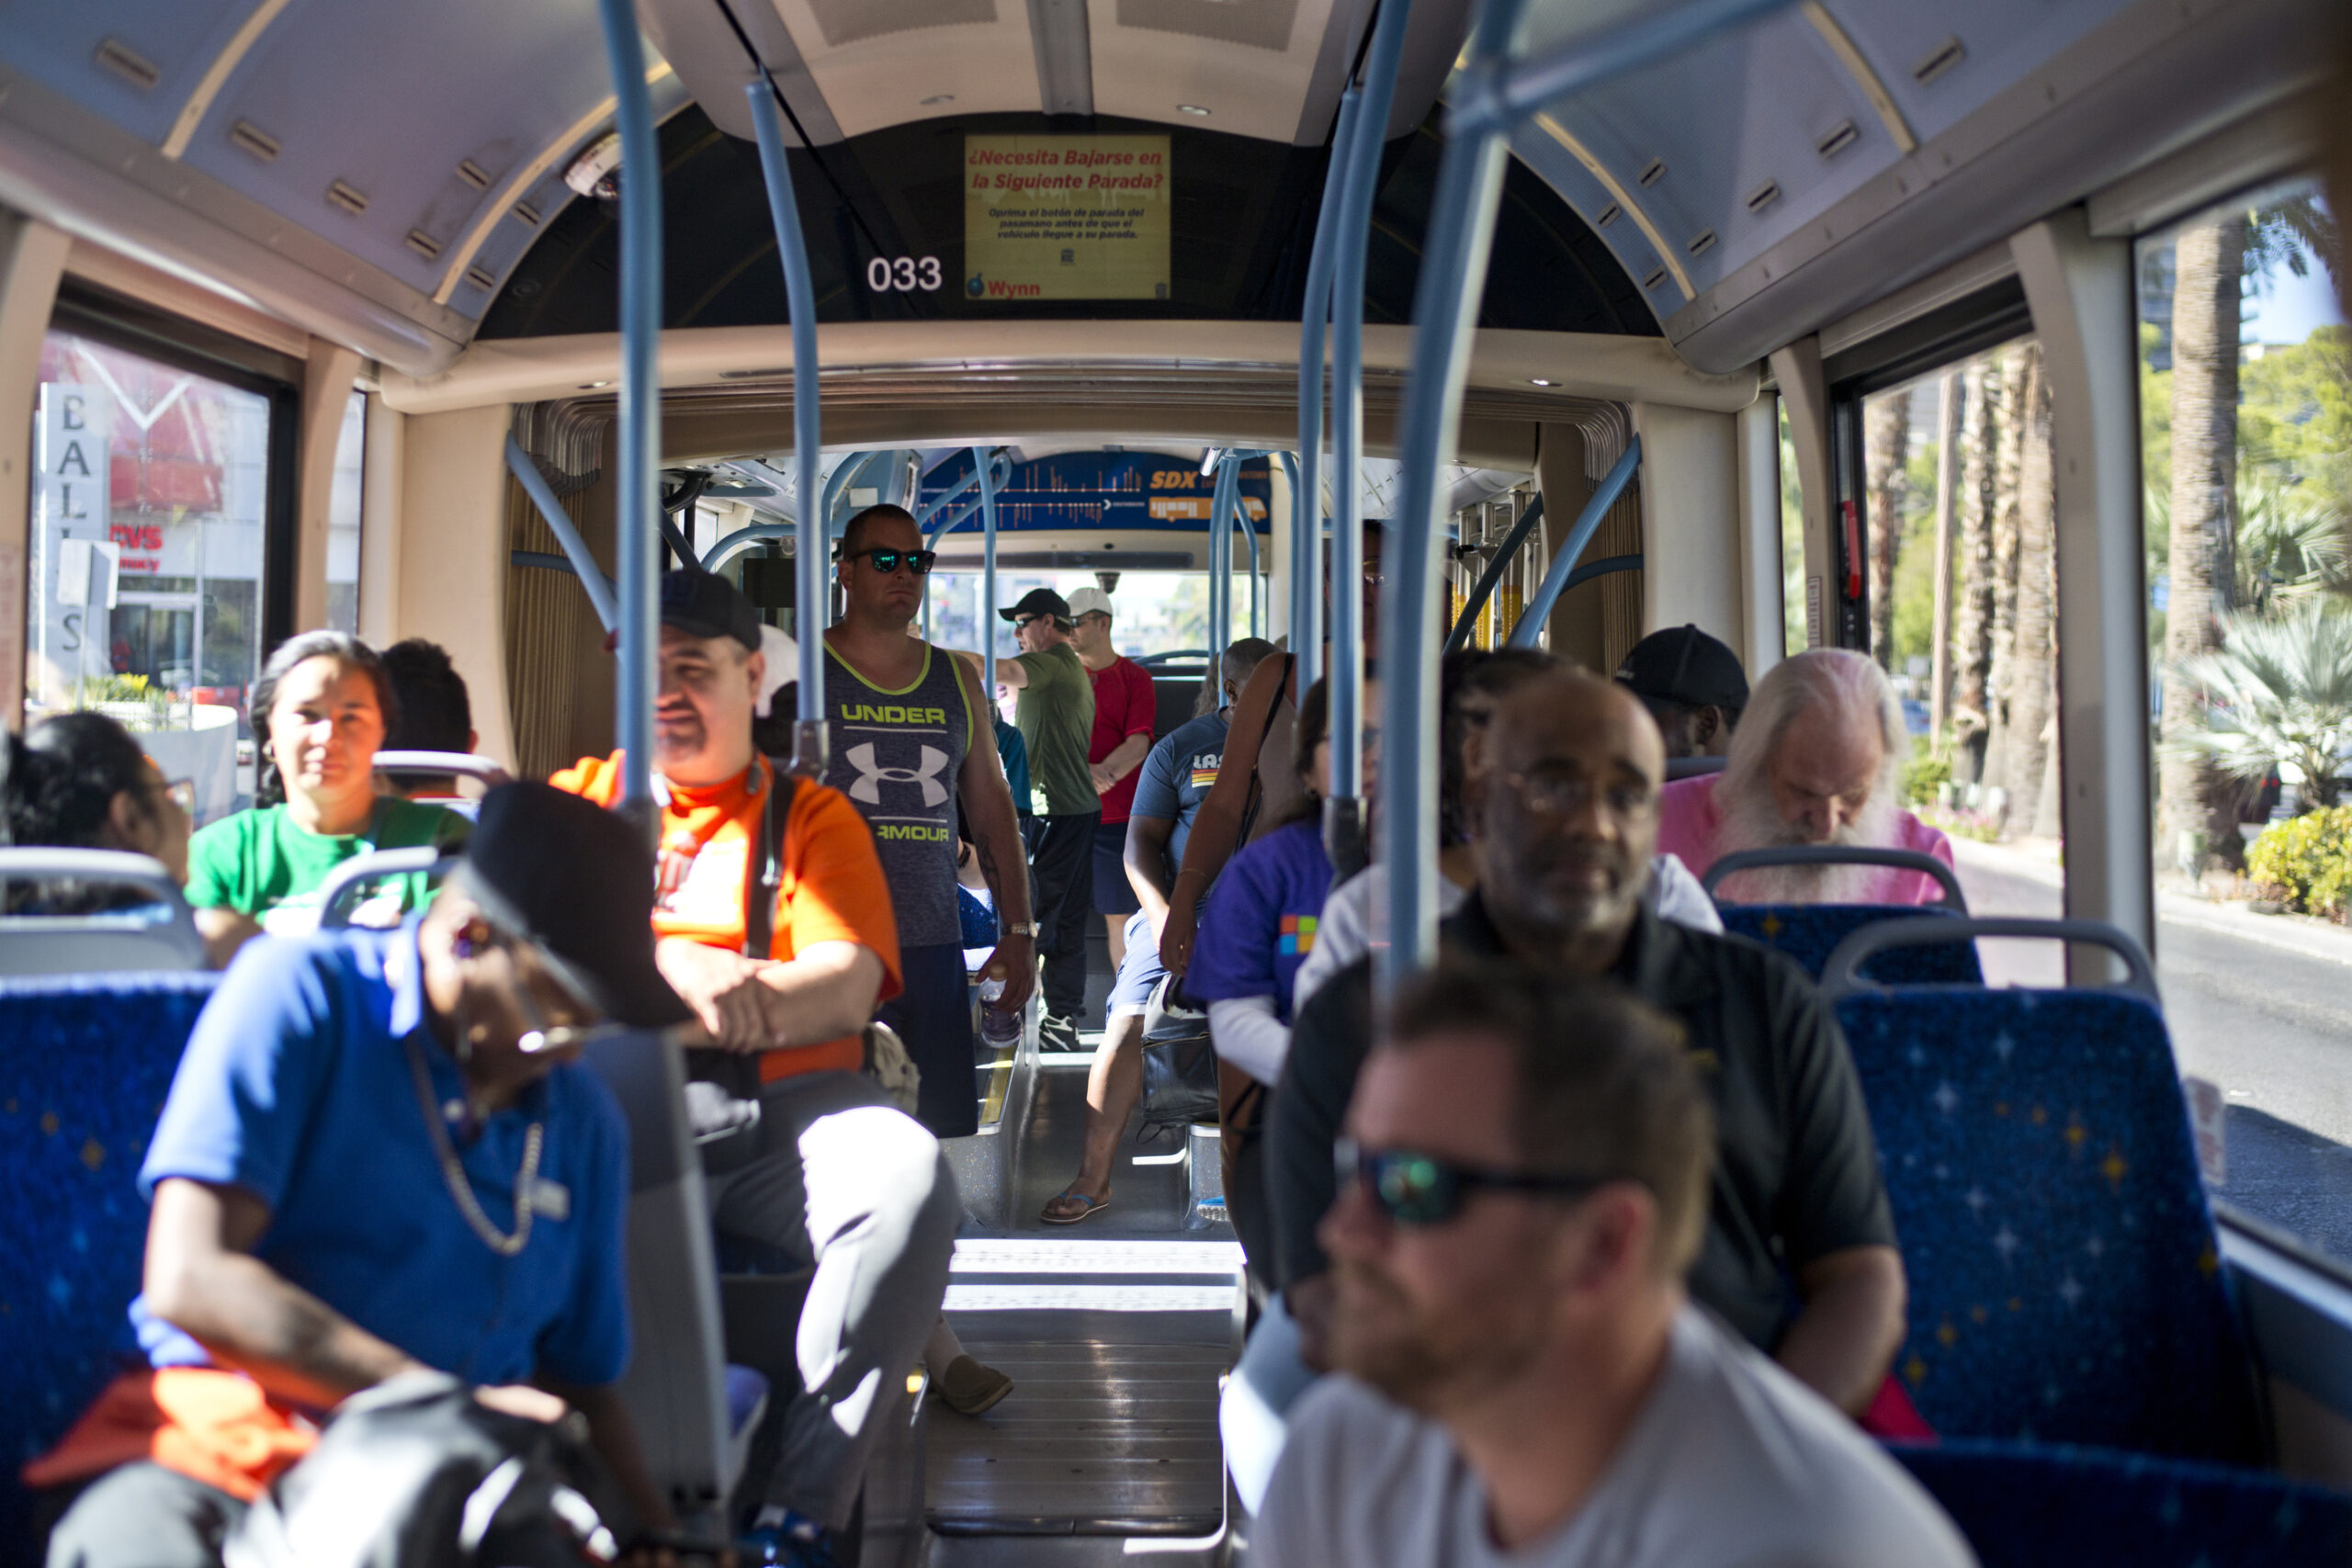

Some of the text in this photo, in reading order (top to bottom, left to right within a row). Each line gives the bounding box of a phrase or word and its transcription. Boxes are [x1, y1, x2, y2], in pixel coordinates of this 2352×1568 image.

[968, 150, 1162, 168] ¿Necesita Bajarse en
[972, 173, 1164, 192] la Siguiente Parada?
[989, 208, 1026, 219] Oprima
[1029, 208, 1038, 218] el
[1074, 208, 1087, 218] de
[1089, 208, 1125, 219] parada
[1127, 208, 1145, 218] del
[1000, 219, 1134, 230] pasamano antes de que el
[1042, 230, 1074, 241] llegue
[867, 256, 943, 292] 033
[988, 280, 1041, 299] Wynn
[1149, 471, 1198, 489] SDX
[57, 393, 91, 652] BALS
[109, 524, 164, 550] CVS
[841, 704, 946, 725] UNDER
[1193, 753, 1224, 770] LA
[876, 825, 949, 842] RMOUR
